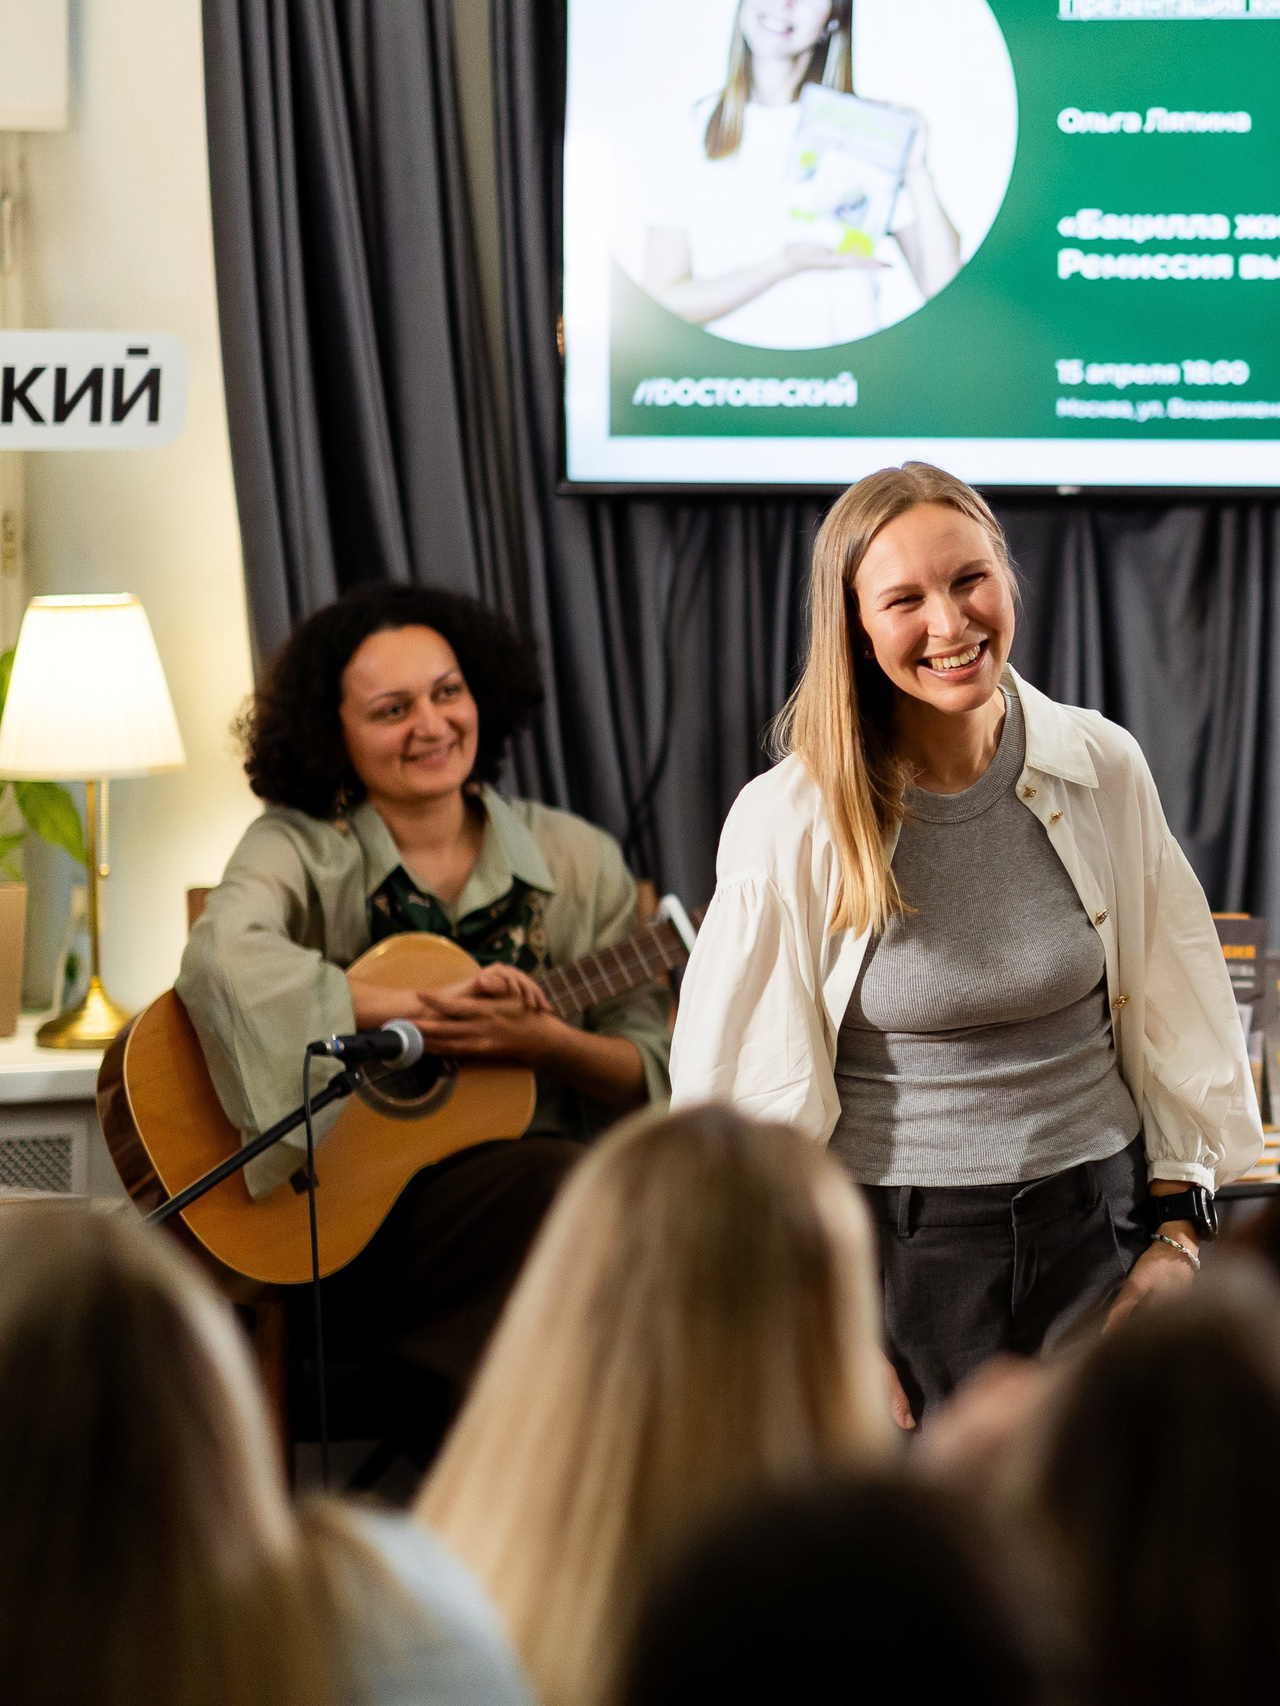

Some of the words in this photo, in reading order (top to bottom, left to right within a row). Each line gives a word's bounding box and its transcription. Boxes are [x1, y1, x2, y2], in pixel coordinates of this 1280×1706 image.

[1057, 107, 1142, 133] Ольга
[1143, 107, 1252, 133] Ляпина
[1057, 208, 1230, 243] «Бацилла
[1057, 248, 1234, 280] Ремиссия
[1, 347, 161, 424] КИЙ
[1085, 363, 1181, 390] апреля
